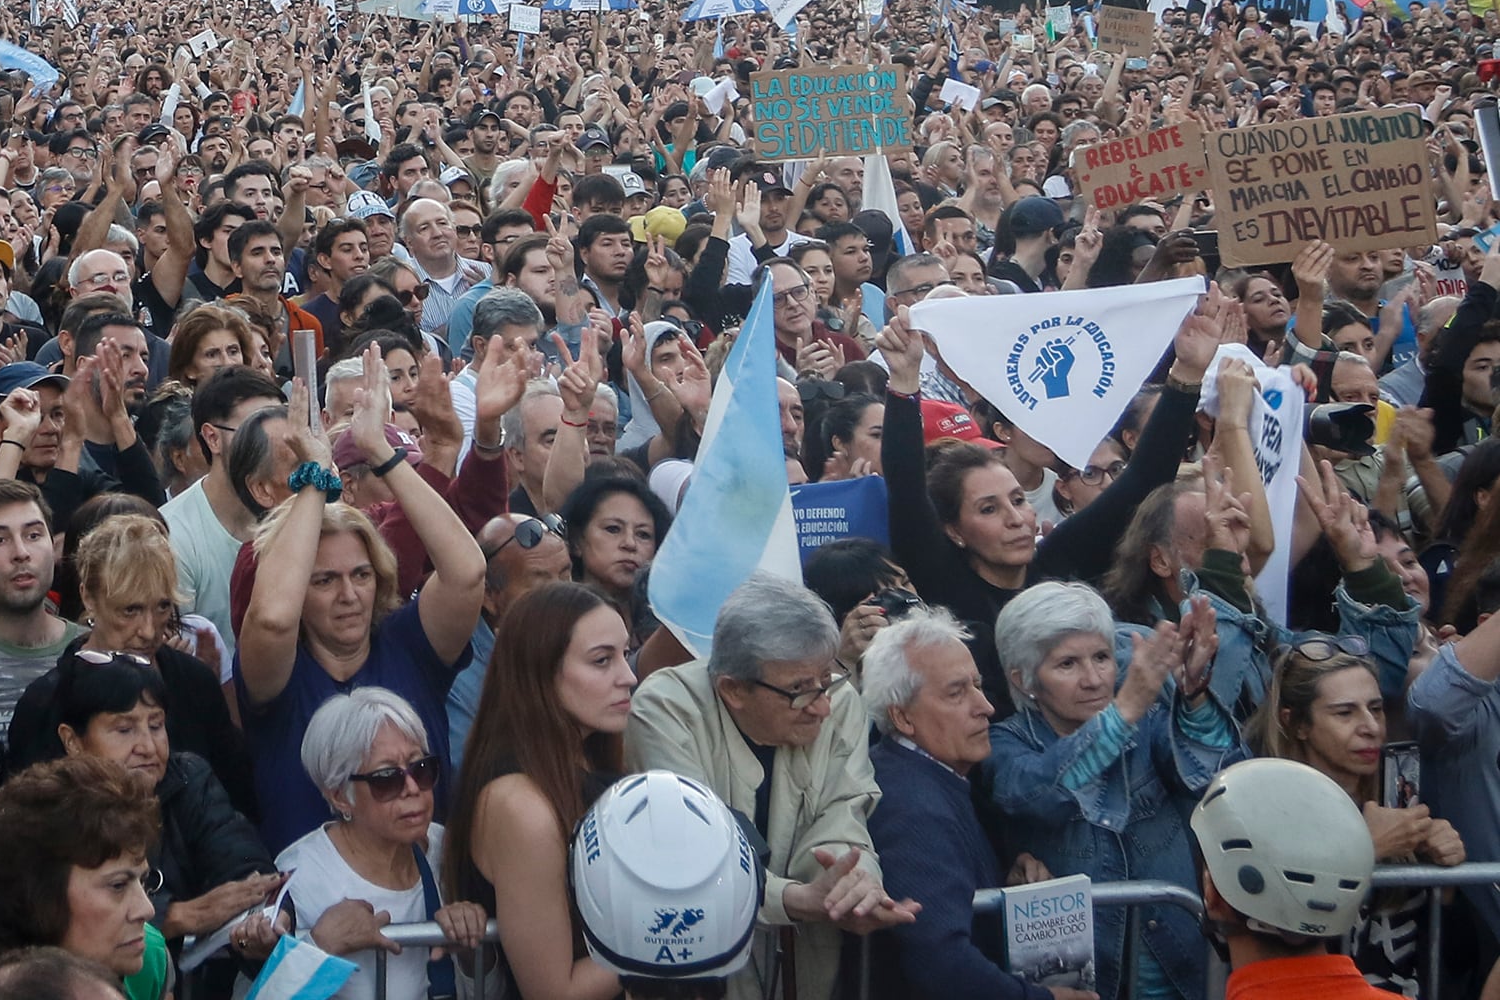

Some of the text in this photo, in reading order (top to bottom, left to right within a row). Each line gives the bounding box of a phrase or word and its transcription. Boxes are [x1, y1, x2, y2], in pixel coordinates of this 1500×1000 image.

[753, 64, 896, 99] LA EDUCACIÓN
[755, 100, 790, 121] NO
[796, 96, 820, 120] SE
[1217, 108, 1425, 158] CUÁNDO LA JUVENTUD
[1085, 124, 1185, 169] REBELATE
[1129, 161, 1143, 178] &
[1225, 147, 1369, 183] SE PONE EN
[1093, 162, 1194, 209] EDUCATE
[1230, 179, 1310, 212] MARCHA
[1322, 174, 1349, 198] EL
[1233, 195, 1426, 248] ES INEVITABLE
[1006, 315, 1116, 411] LUCHEMOS POR LA EDUCACIÓN
[794, 508, 845, 520] YO DEFIENDO
[801, 519, 849, 533] EDUCACIÓN
[1014, 892, 1085, 920] NÉSTOR
[1015, 912, 1086, 933] EL HOMBRE QUE
[1059, 922, 1086, 936] TODO
[1298, 922, 1326, 933] 360
[644, 936, 695, 945] GUTIERREZ
[655, 946, 693, 963] A+
